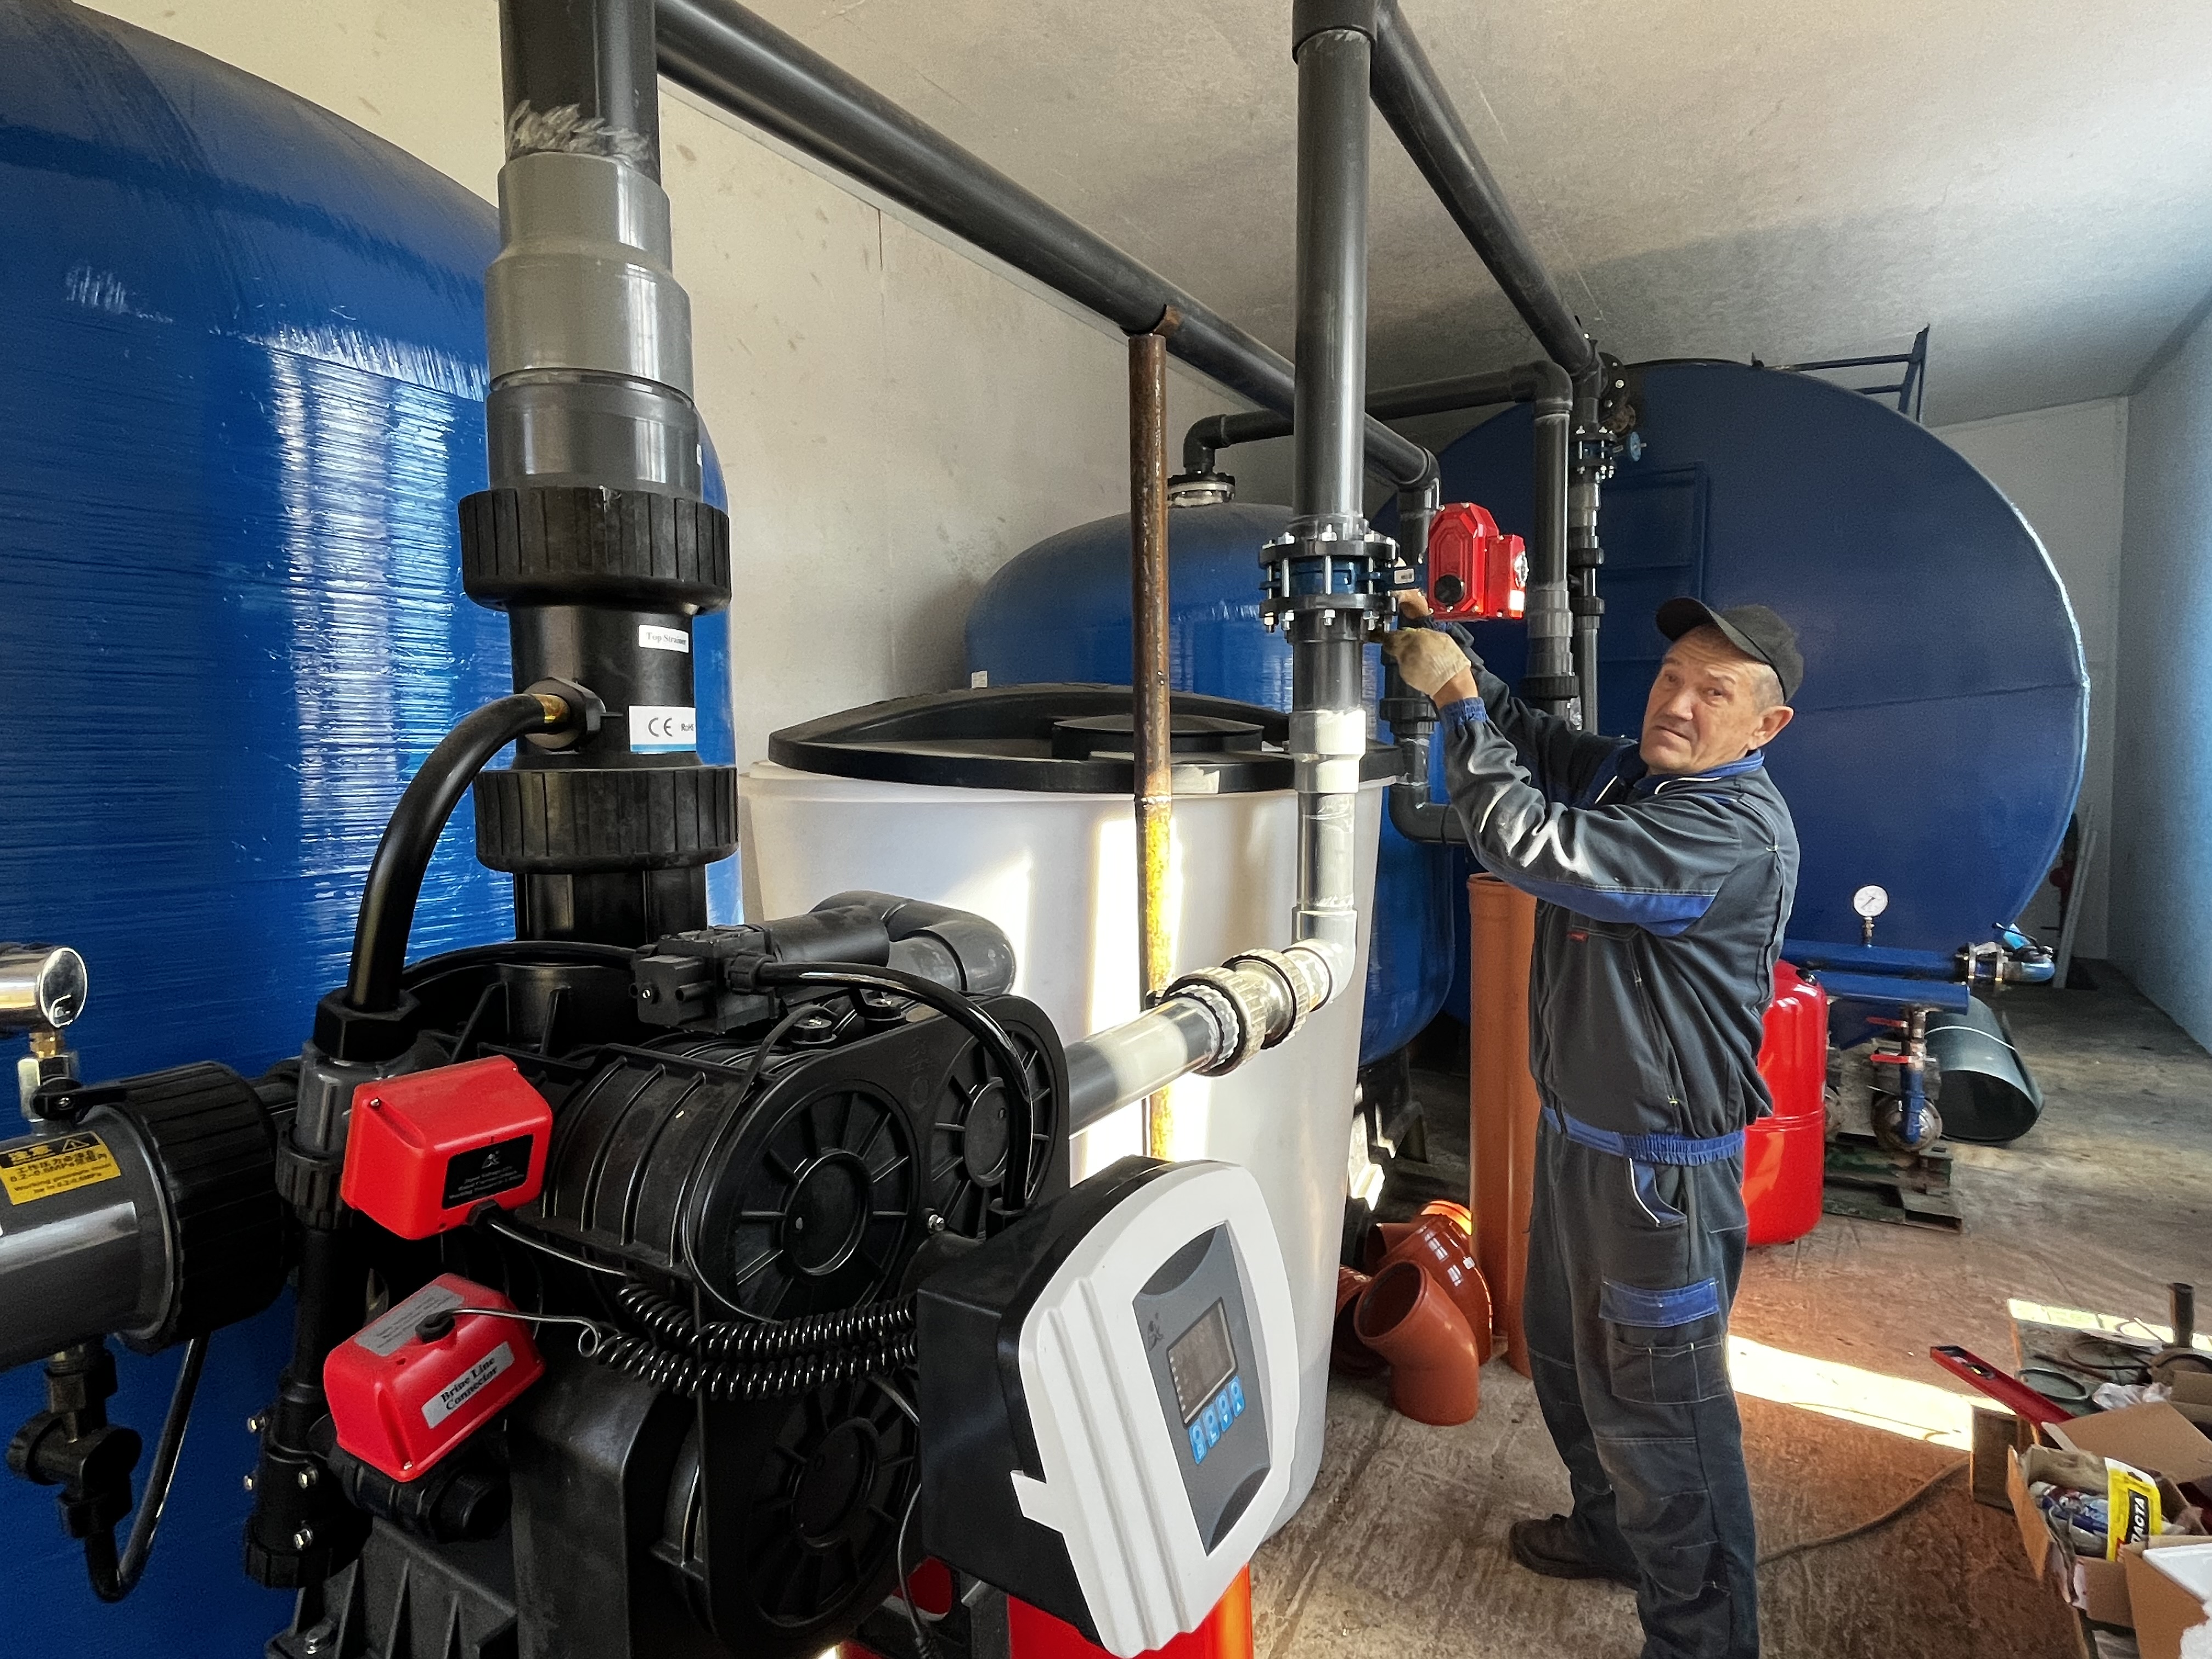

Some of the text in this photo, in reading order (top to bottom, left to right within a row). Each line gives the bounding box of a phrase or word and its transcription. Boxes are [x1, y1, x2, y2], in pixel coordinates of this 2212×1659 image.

[646, 631, 662, 644] Top
[647, 717, 673, 737] CE
[440, 1357, 494, 1403] Brine Line
[445, 1365, 498, 1410] Connector
